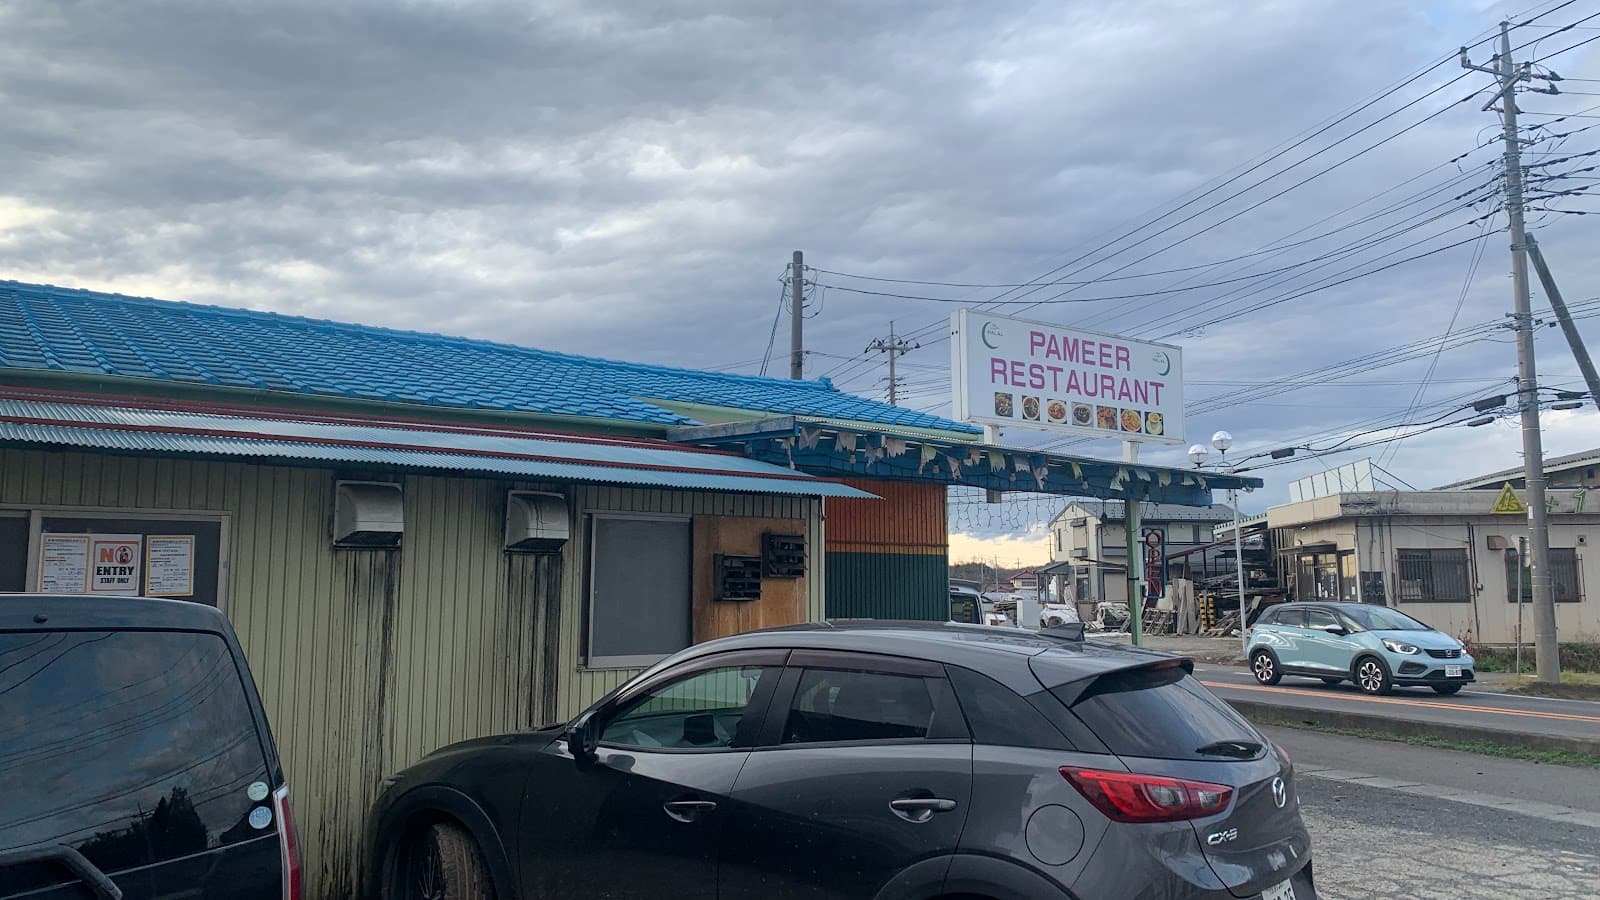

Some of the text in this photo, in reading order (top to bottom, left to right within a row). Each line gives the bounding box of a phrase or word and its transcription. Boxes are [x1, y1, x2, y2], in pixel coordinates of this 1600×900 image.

[1029, 330, 1131, 372] PAMEER
[990, 357, 1165, 406] RESTAURANT
[96, 566, 135, 576] ENTRY
